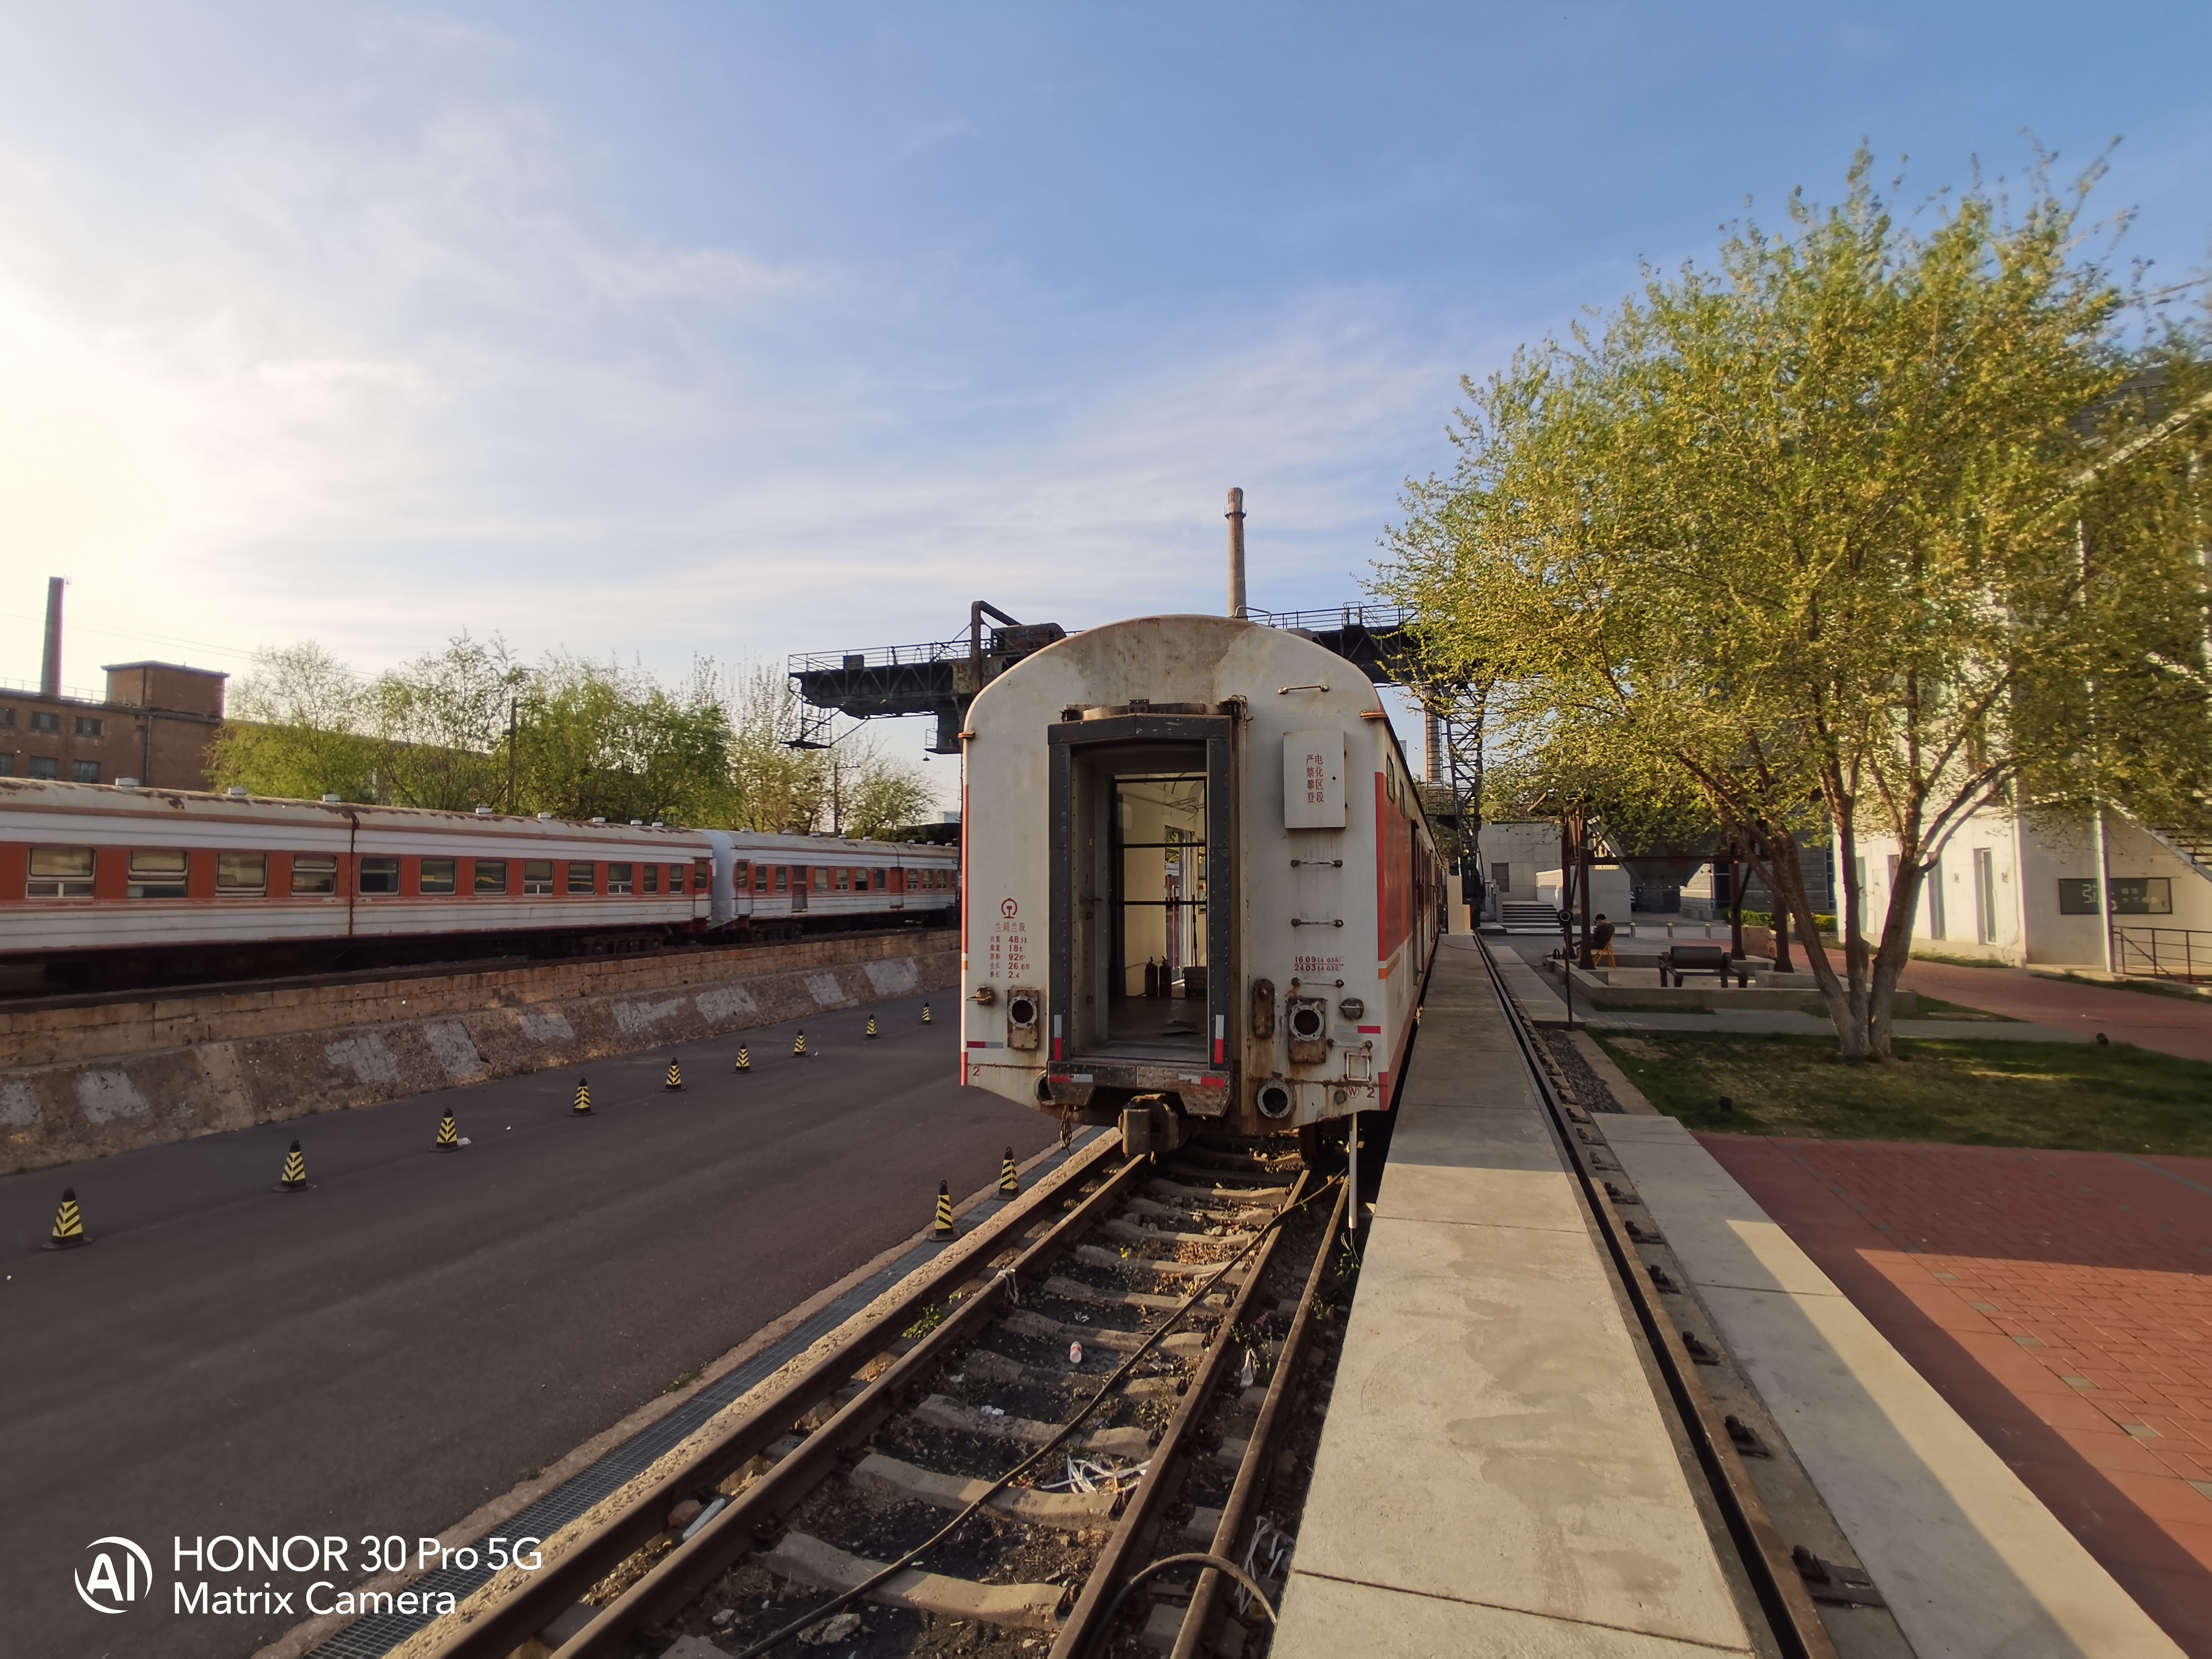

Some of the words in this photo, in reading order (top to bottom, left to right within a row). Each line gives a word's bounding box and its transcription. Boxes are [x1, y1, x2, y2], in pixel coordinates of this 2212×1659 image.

[1306, 754, 1315, 803] 严禁攀登
[1314, 753, 1324, 803] 电化区段
[973, 1065, 980, 1076] 2
[1366, 1087, 1375, 1098] 2
